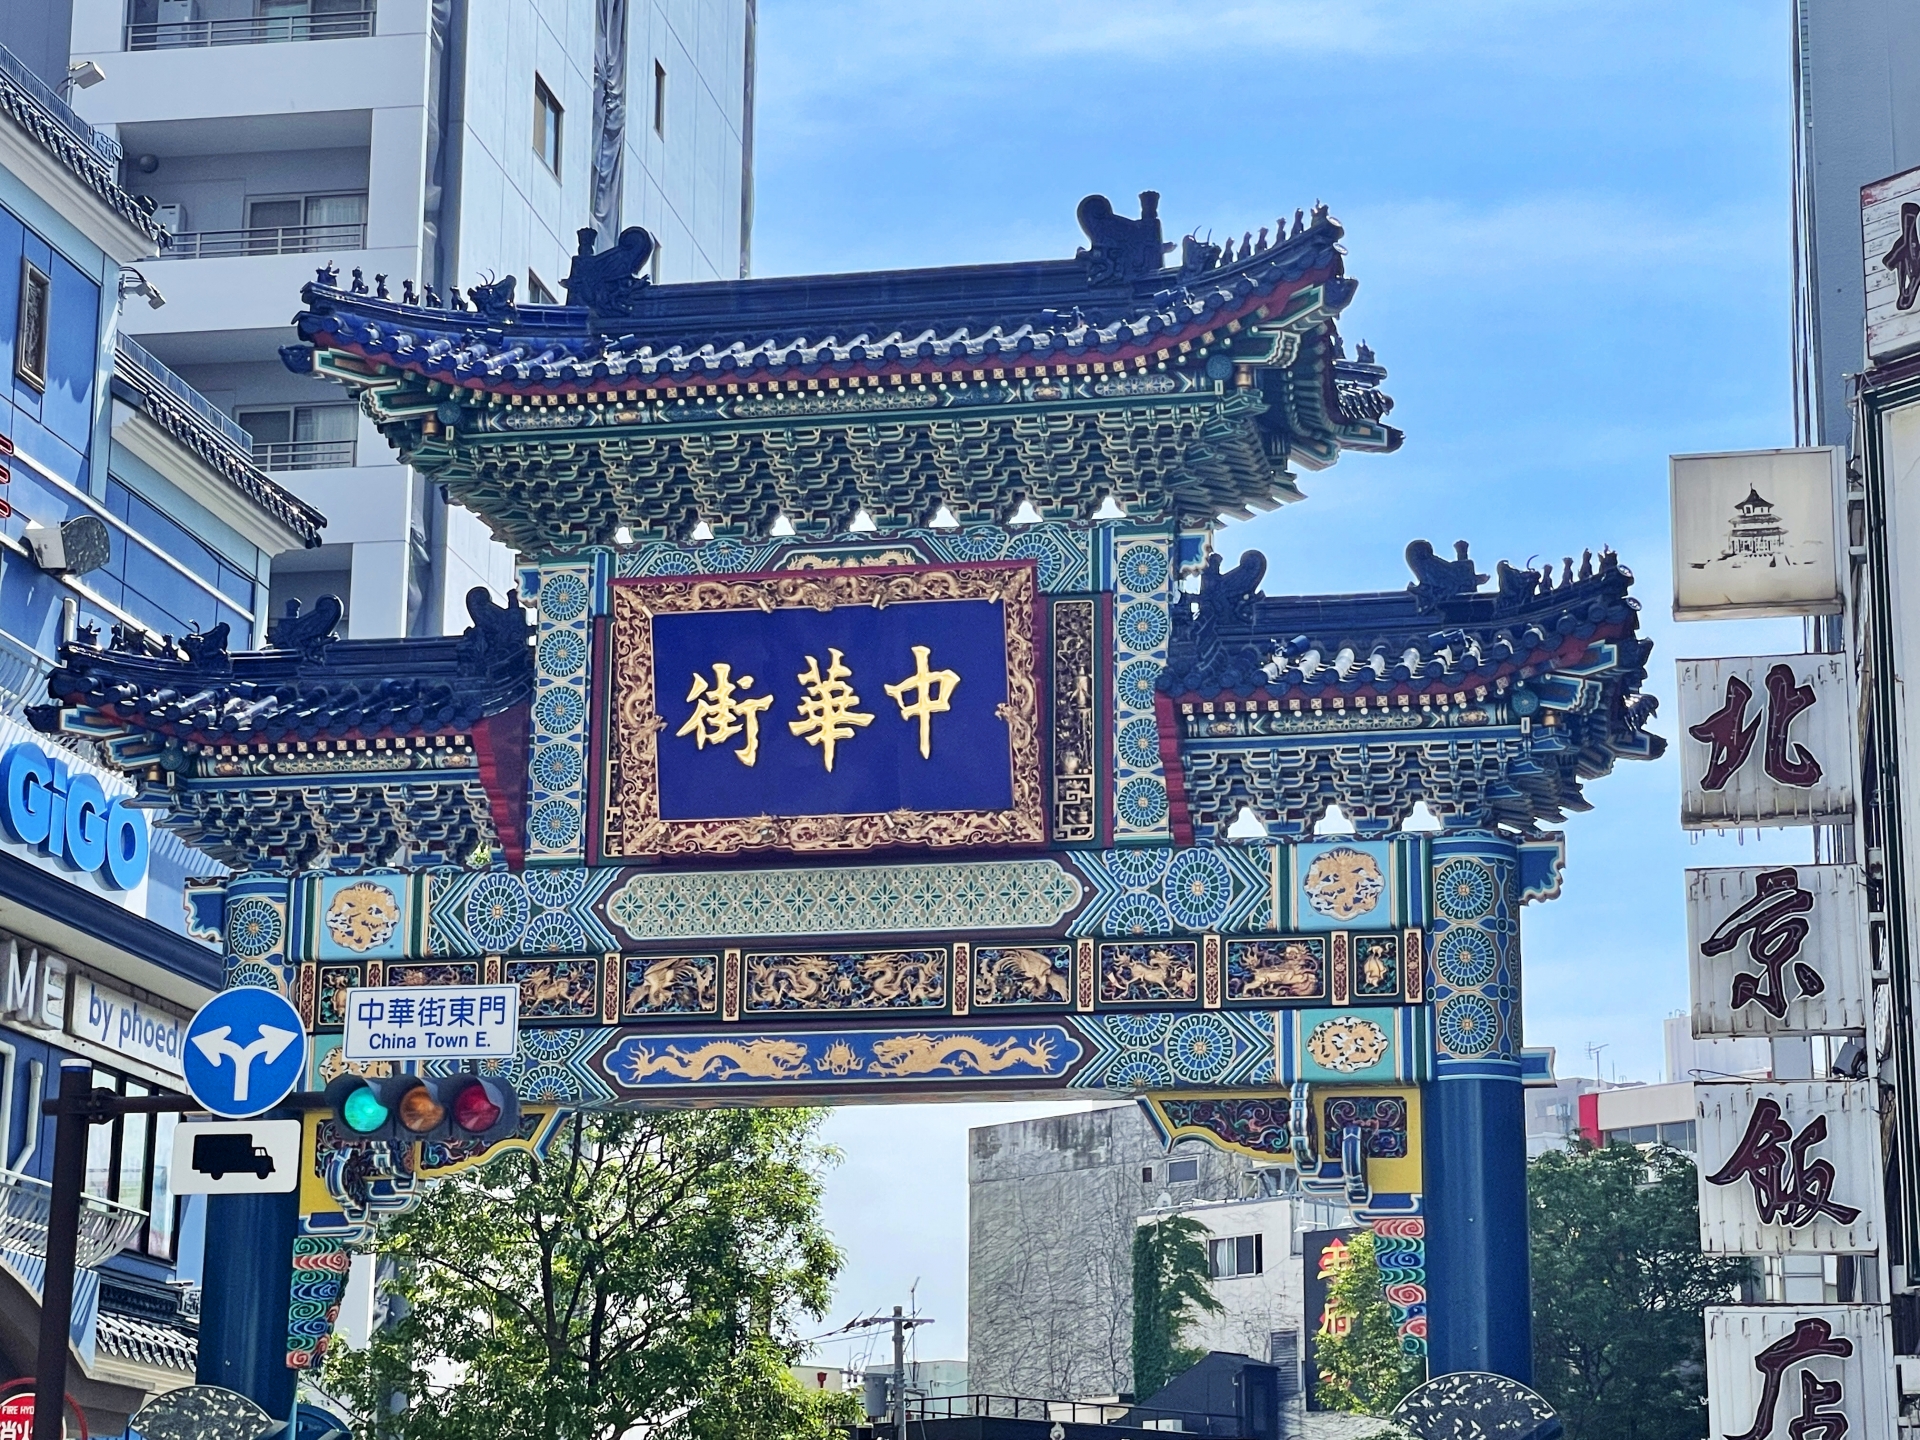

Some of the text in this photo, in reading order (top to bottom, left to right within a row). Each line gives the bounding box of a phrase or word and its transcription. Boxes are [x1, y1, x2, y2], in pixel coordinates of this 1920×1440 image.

[88, 983, 114, 1042] by
[358, 995, 506, 1030] 中華街東門
[369, 1031, 491, 1050] China Town E.
[2, 1405, 19, 1415] FIRE
